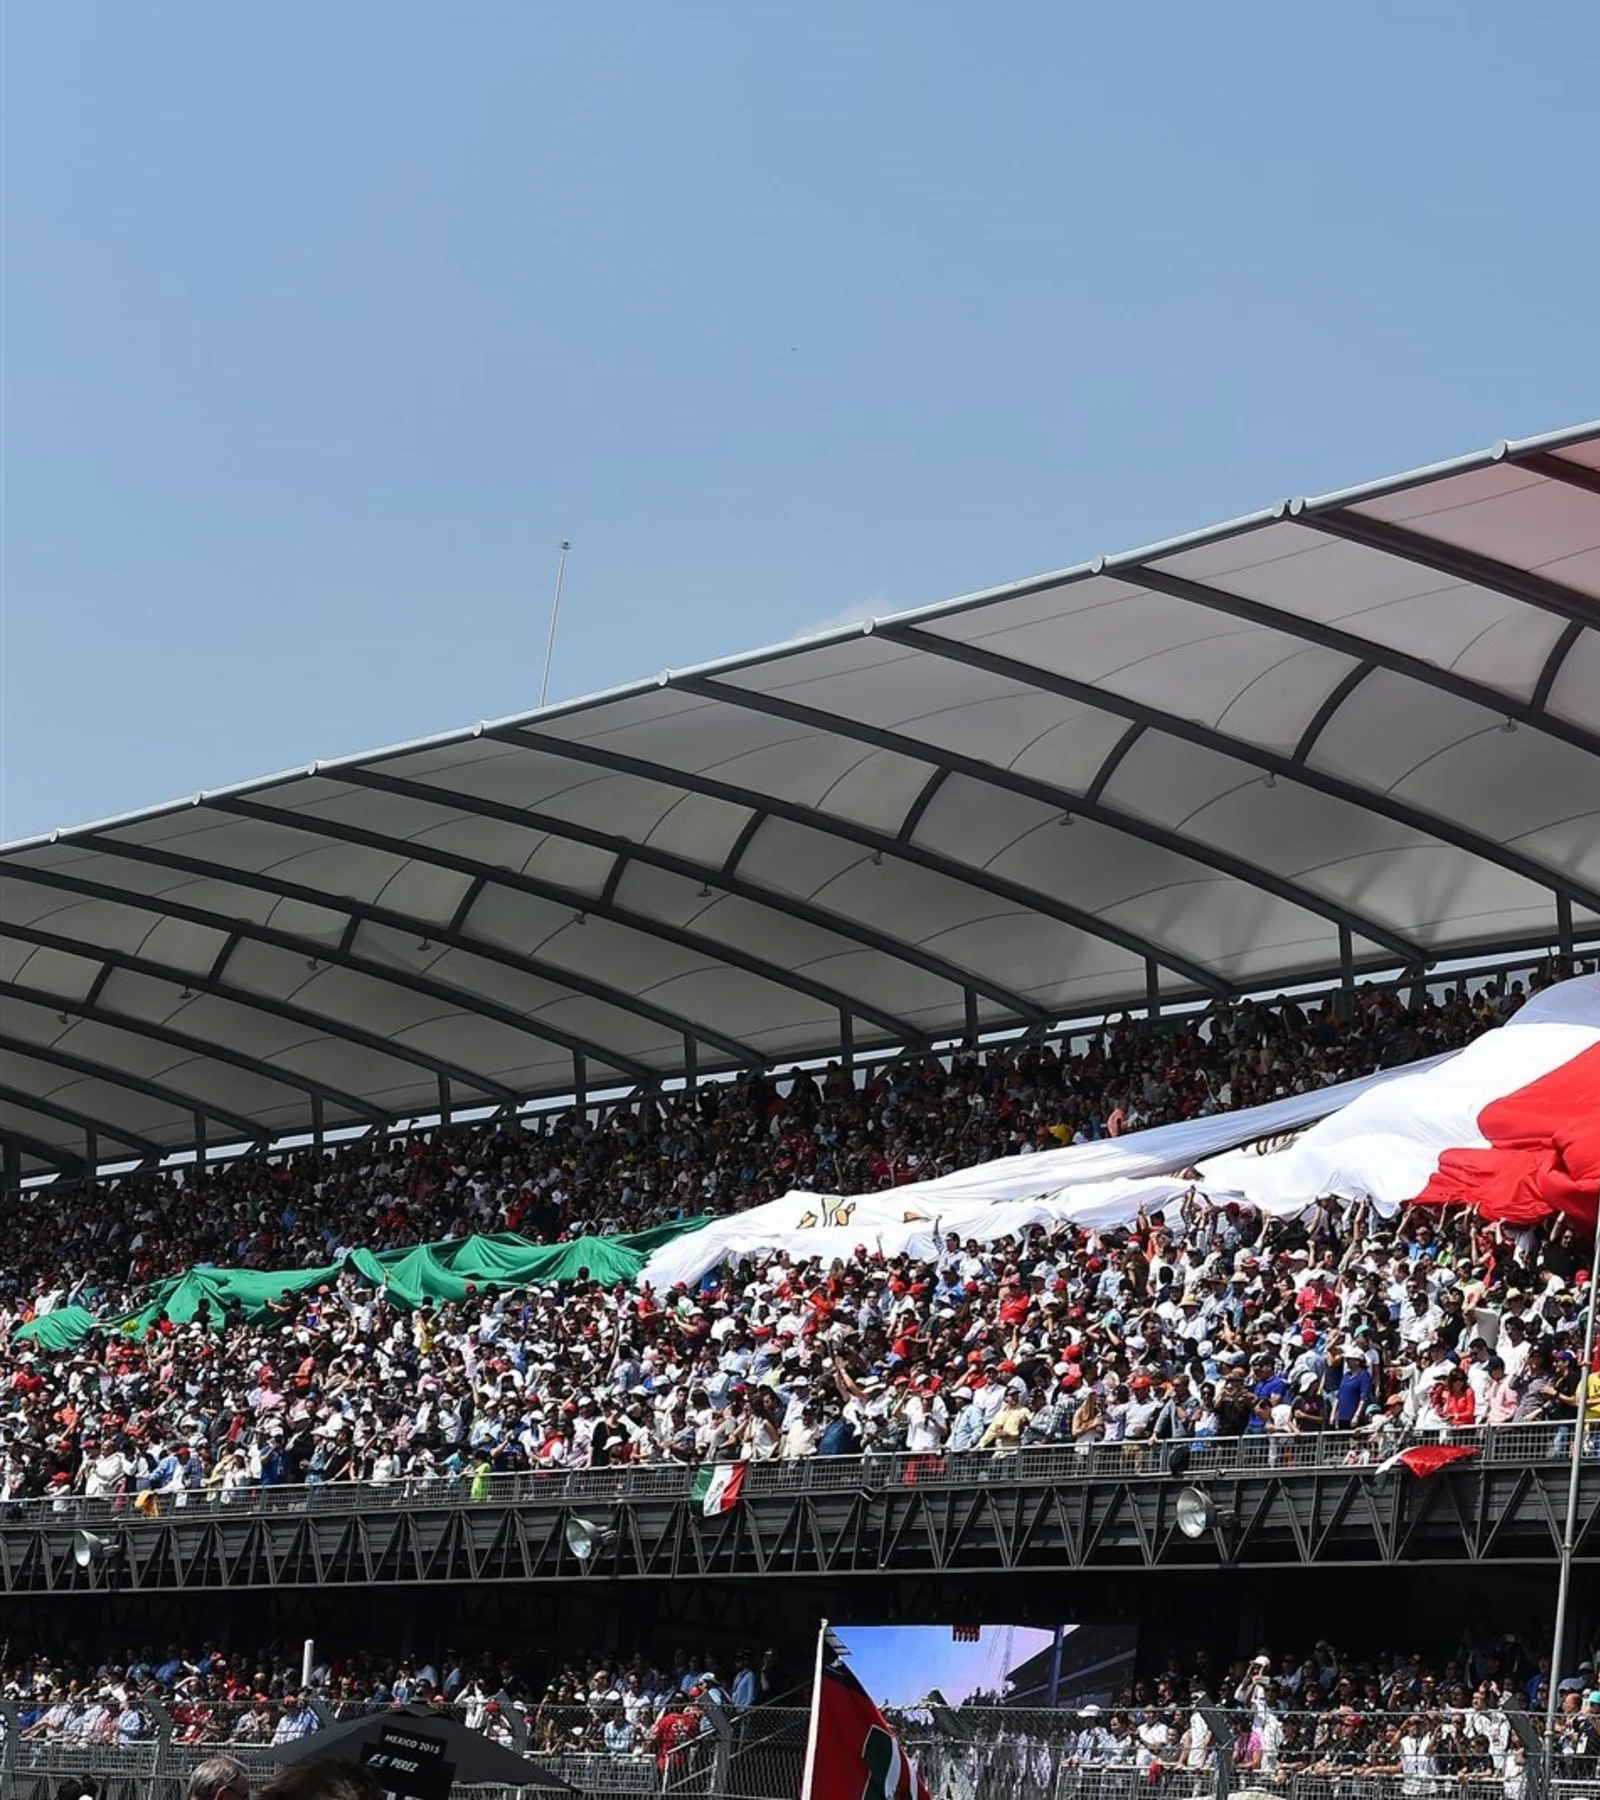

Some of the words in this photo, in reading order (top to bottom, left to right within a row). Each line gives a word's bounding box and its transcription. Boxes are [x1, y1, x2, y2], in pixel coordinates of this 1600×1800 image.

[385, 1734, 418, 1749] MEXICO
[419, 1742, 440, 1754] 2015
[390, 1757, 420, 1773] PEREZ
